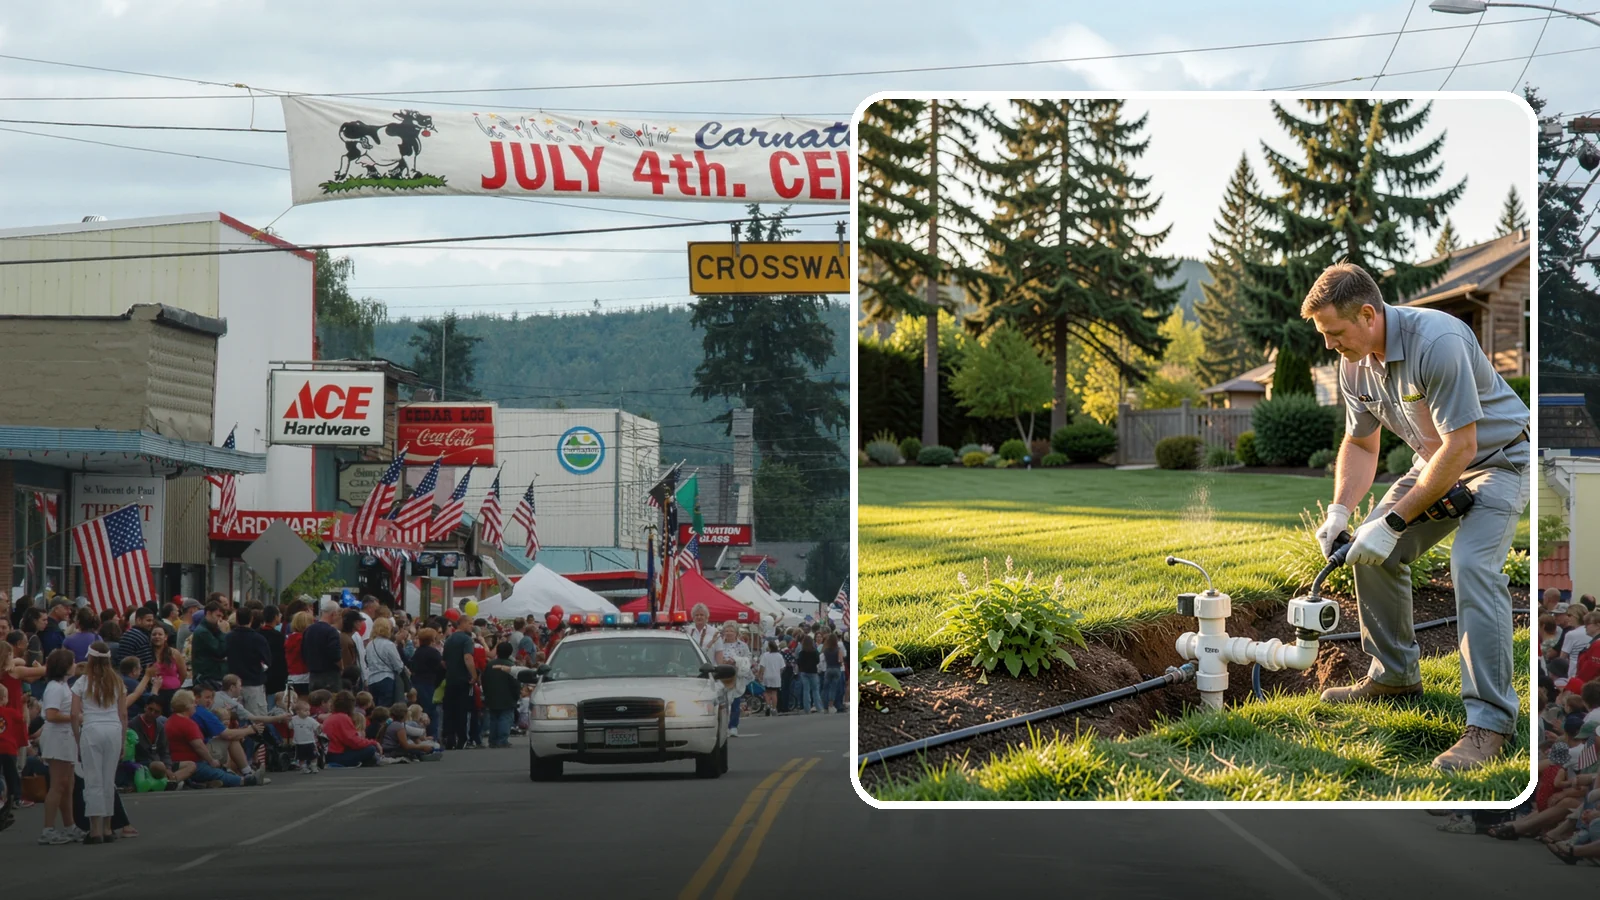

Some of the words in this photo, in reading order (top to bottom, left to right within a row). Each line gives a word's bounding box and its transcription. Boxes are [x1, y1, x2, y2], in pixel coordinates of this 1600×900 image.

[481, 141, 604, 193] JULY
[632, 150, 747, 198] 4th.
[697, 254, 850, 280] CROSSWA
[283, 380, 373, 420] ACE
[406, 409, 453, 422] CEDAR
[283, 421, 371, 436] Hardware
[416, 428, 477, 447] Coca-Cola
[96, 485, 124, 495] Vincent
[126, 486, 136, 495] de
[138, 486, 155, 495] Paul
[688, 526, 741, 535] CRNATION
[699, 535, 730, 543] GLASS
